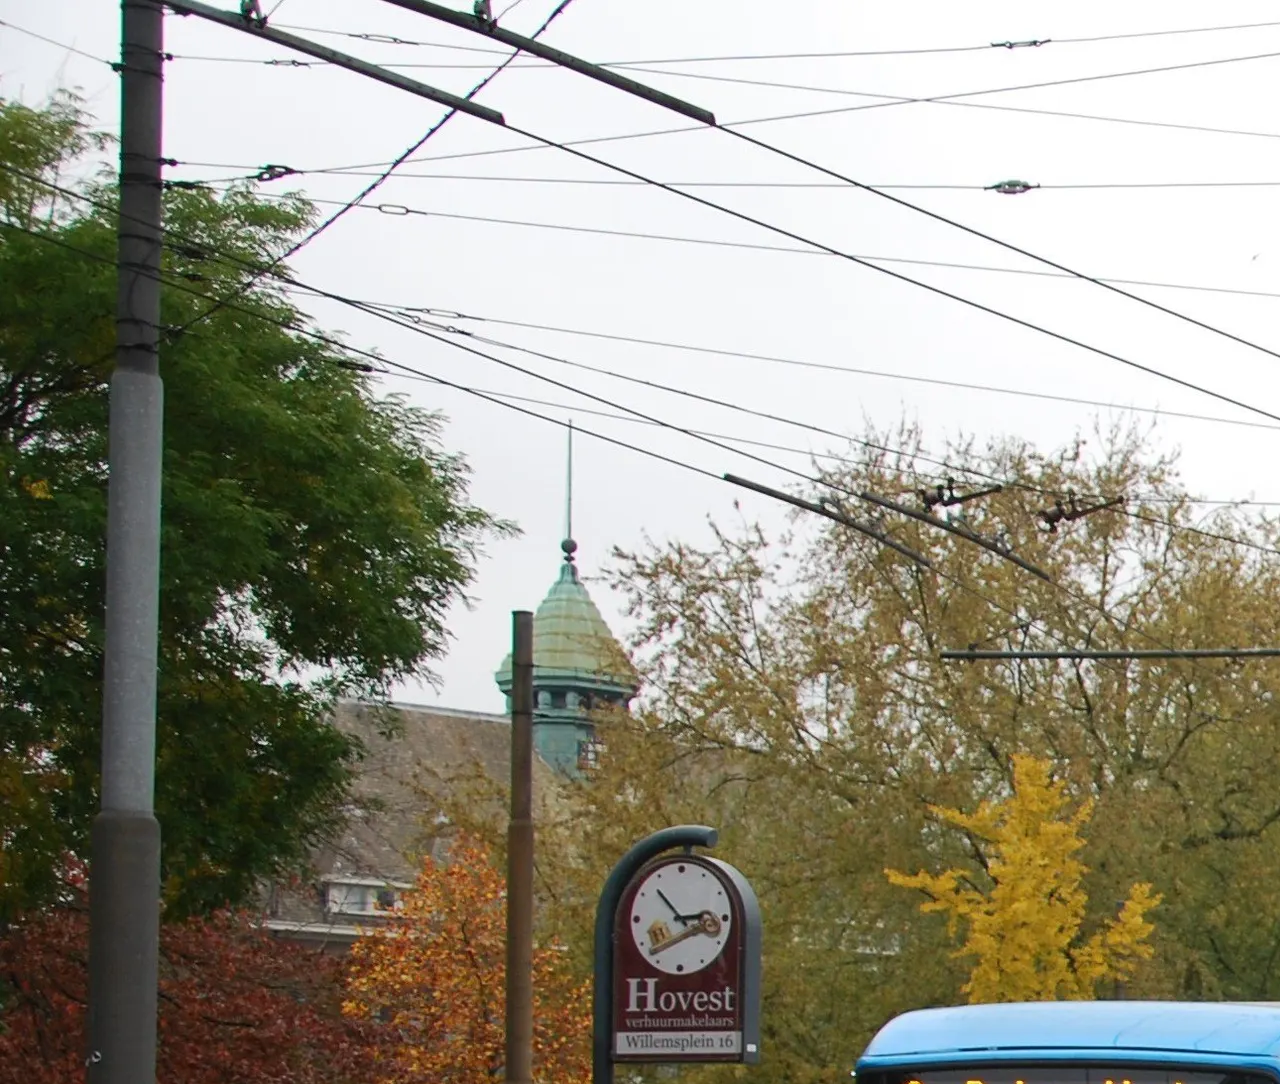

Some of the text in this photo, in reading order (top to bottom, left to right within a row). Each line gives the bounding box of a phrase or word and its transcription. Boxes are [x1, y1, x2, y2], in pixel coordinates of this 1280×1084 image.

[625, 978, 735, 1012] Hovest
[625, 1013, 734, 1028] verhuurmakelaars
[626, 1034, 733, 1051] Willemsplein 16
